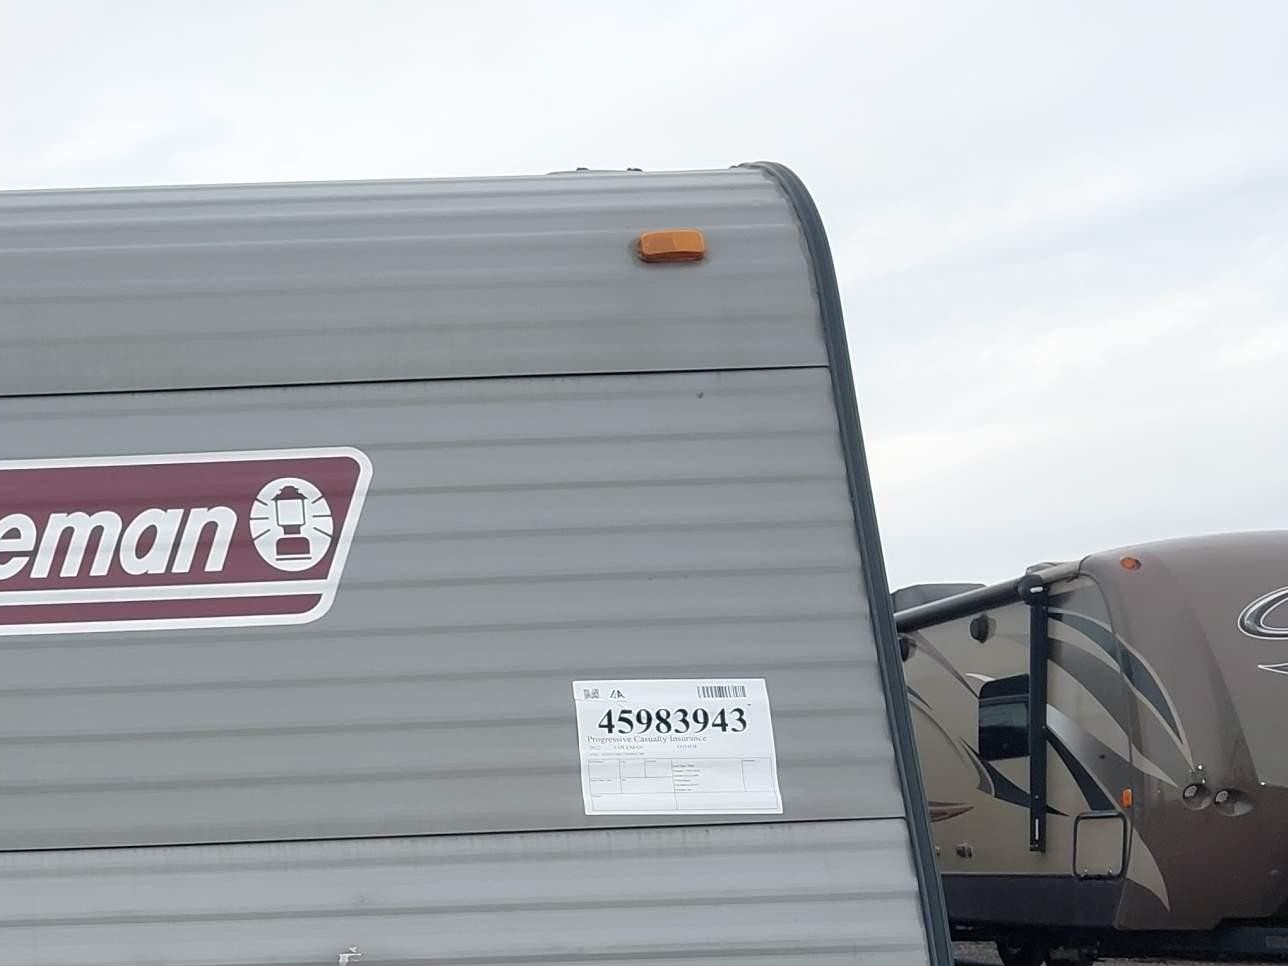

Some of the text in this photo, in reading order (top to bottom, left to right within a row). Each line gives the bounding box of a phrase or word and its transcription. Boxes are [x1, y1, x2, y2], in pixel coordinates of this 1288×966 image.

[597, 707, 748, 735] 45983943
[587, 735, 707, 745] Progressive Casualty Insurance
